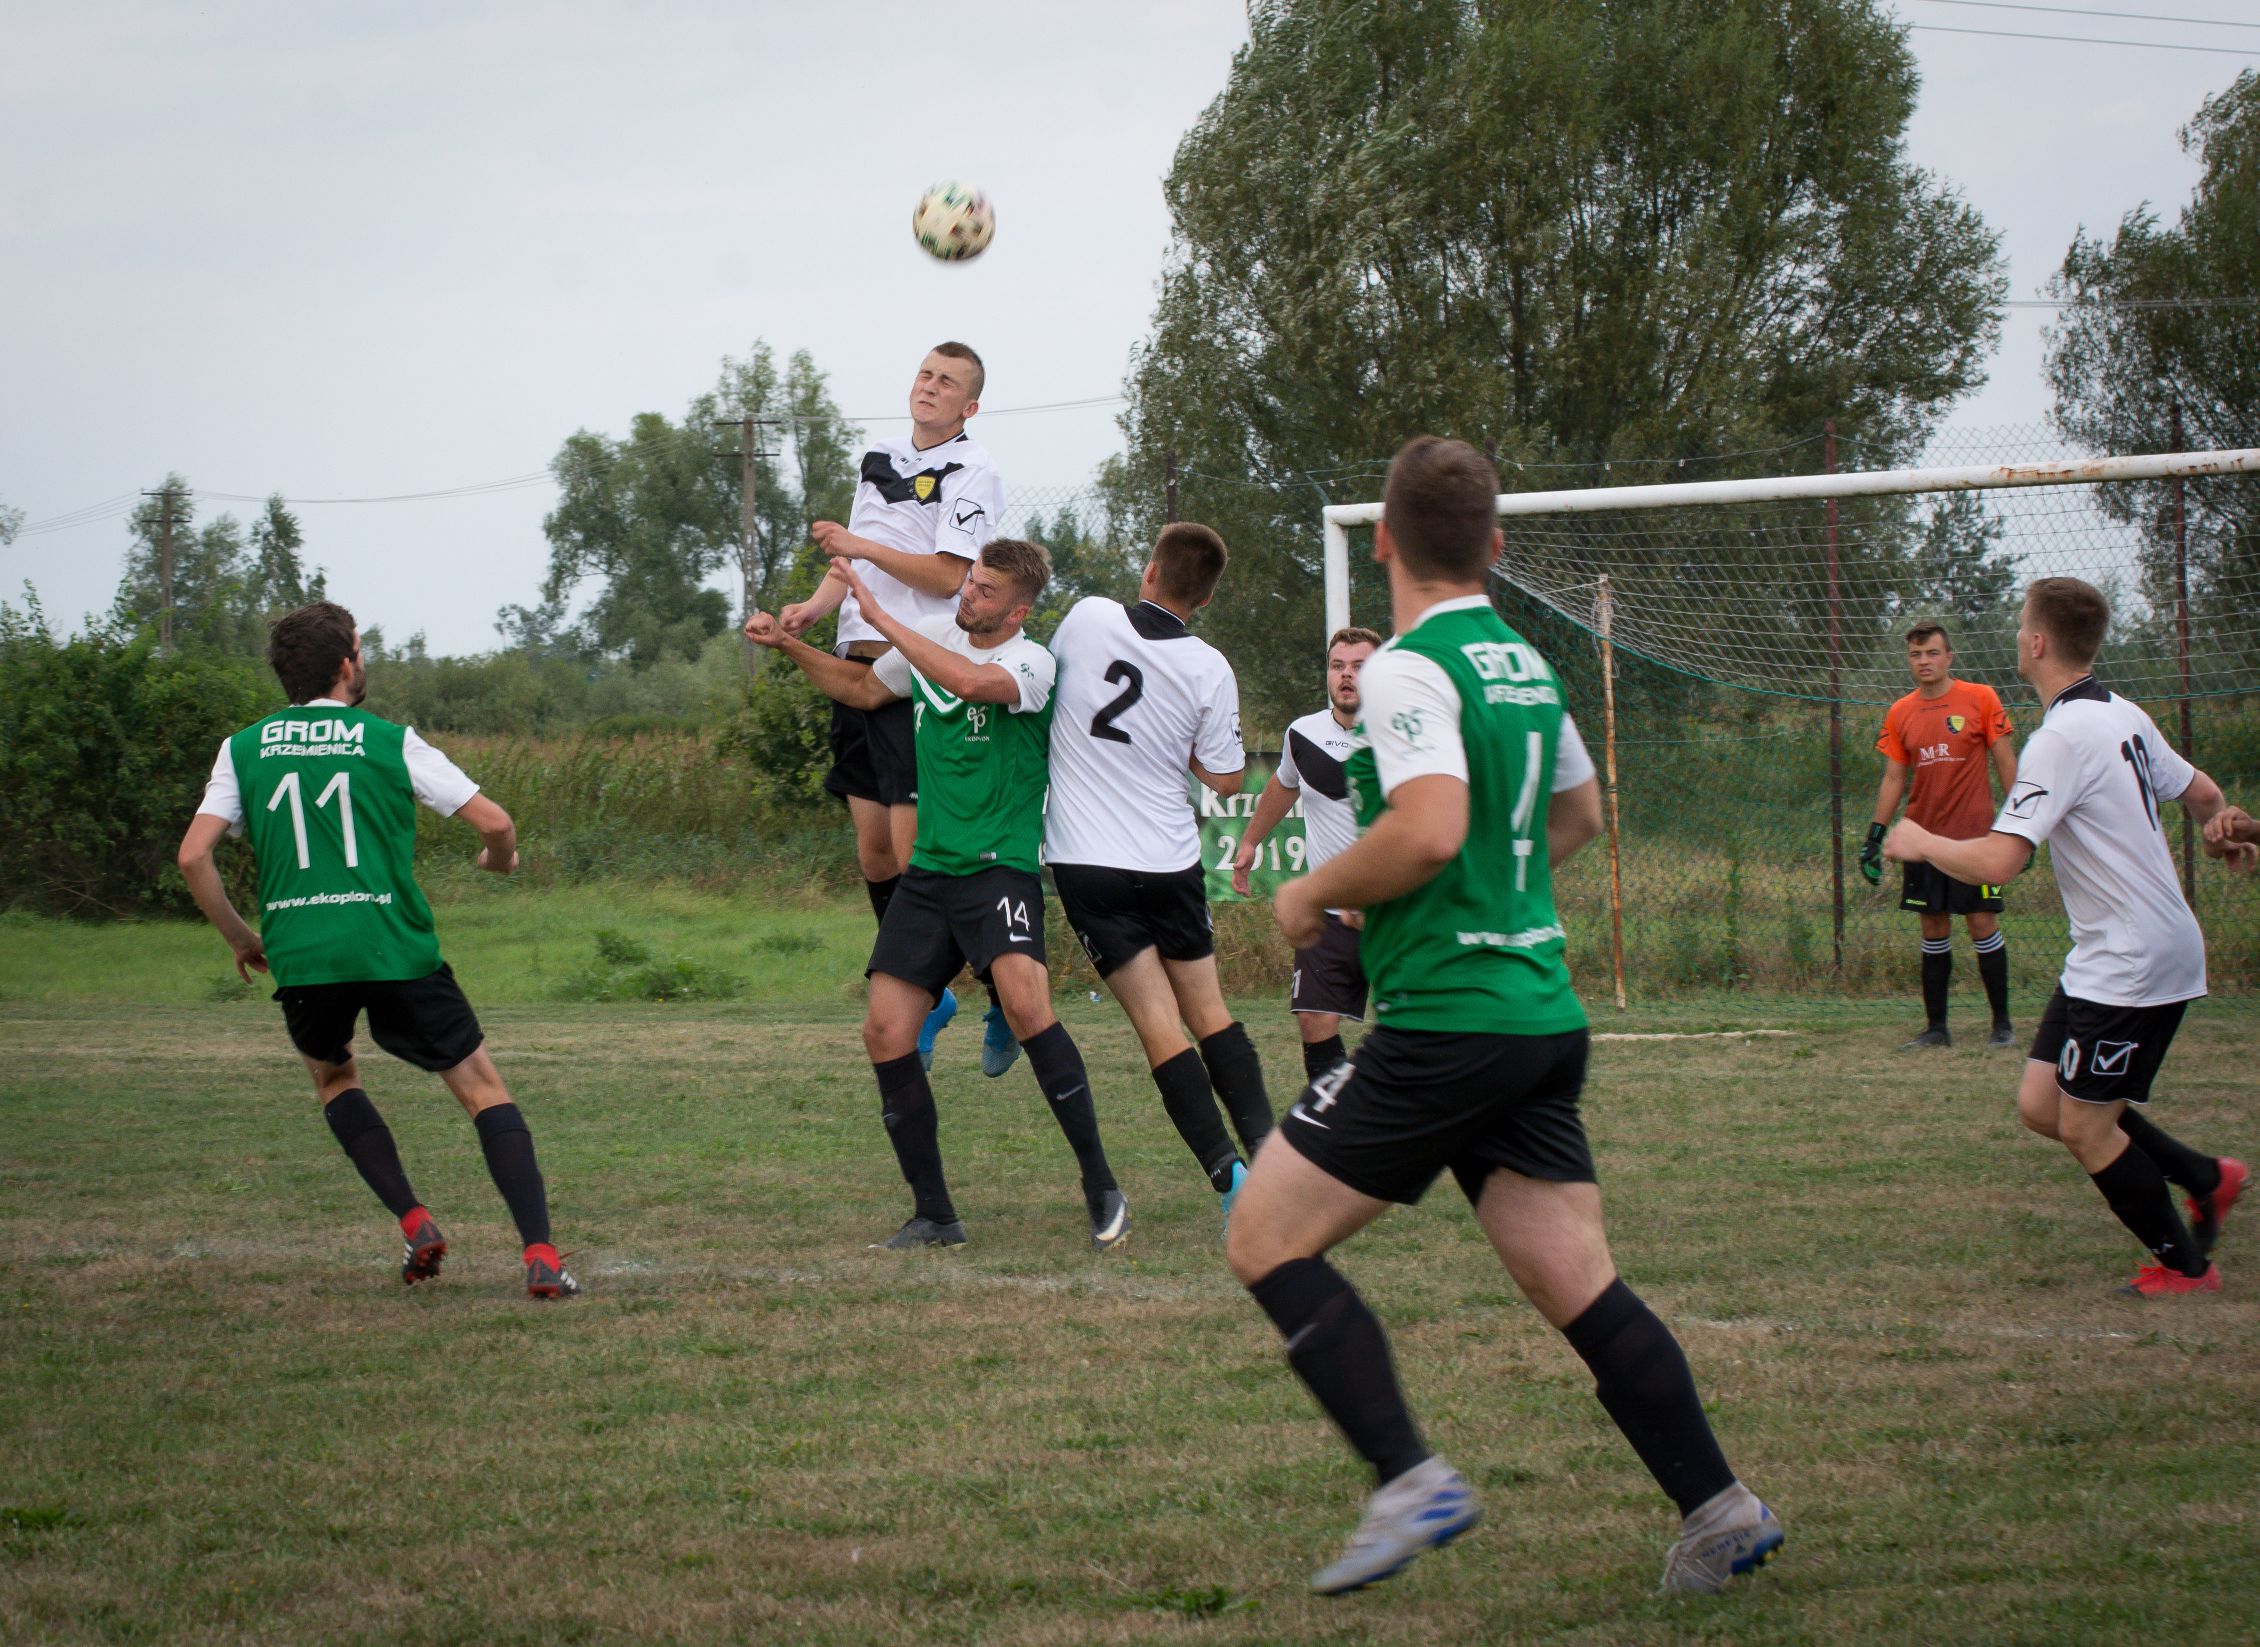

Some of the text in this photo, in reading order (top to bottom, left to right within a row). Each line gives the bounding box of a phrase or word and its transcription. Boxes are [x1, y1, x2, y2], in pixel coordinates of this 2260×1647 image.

[1090, 659, 1144, 745] 2
[261, 719, 365, 744] GROM
[260, 742, 365, 759] KRZEMIENICA
[1325, 740, 1349, 749] GIVO
[266, 772, 359, 870] 11
[266, 890, 392, 911] www.ekoplon.pl
[997, 896, 1031, 932] 14
